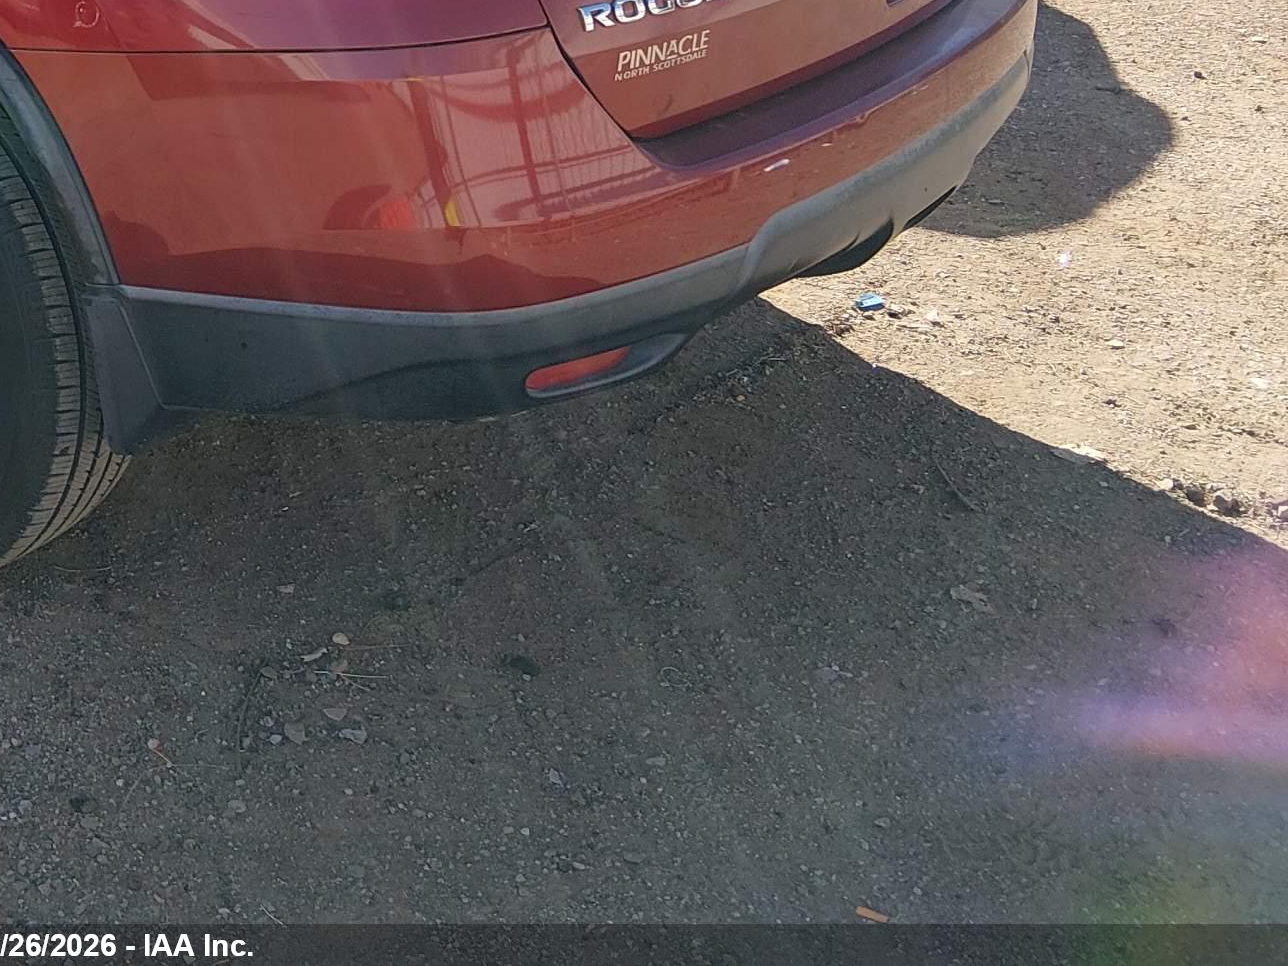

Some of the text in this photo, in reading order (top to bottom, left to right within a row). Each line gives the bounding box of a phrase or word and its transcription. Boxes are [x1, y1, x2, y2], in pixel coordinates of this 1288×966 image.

[614, 49, 708, 82] NORTH SCOTTSDALE
[617, 29, 711, 72] PINNACLE
